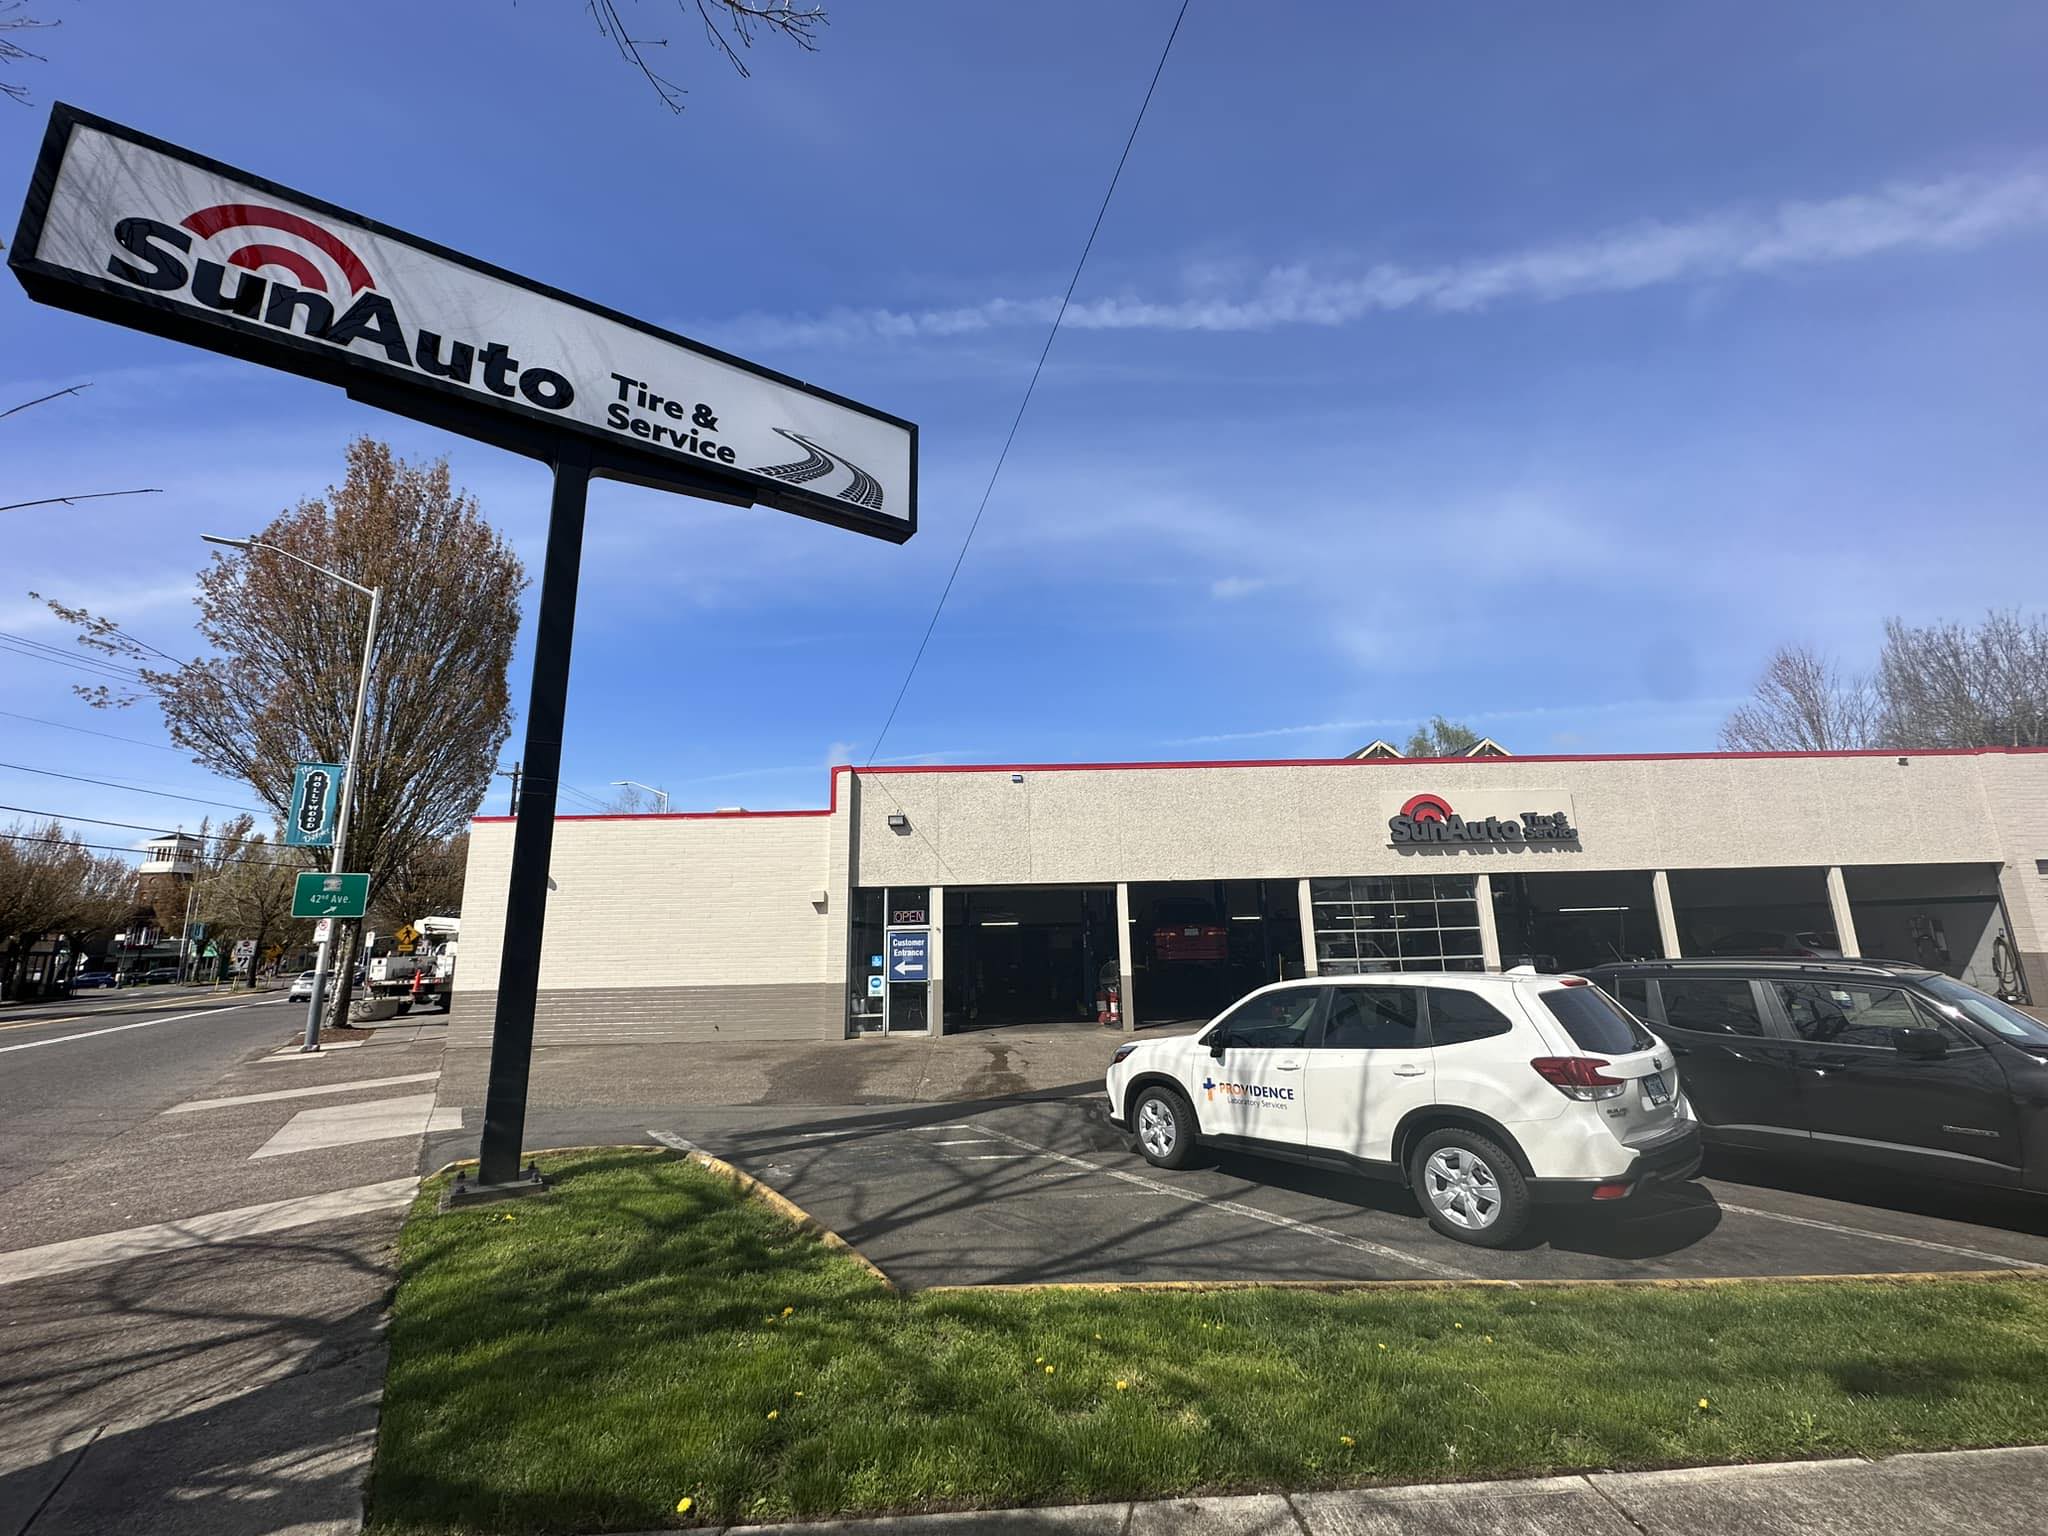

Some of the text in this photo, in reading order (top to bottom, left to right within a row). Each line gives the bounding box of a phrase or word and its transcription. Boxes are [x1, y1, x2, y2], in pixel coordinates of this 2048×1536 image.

[108, 217, 719, 432] SunAuto Tire &
[607, 403, 736, 464] Service
[306, 775, 322, 829] HOLLYWOOD
[1389, 811, 1568, 842] SunAuto Tire &
[1523, 826, 1578, 840] Service
[310, 894, 351, 904] 42nd Ave.
[895, 911, 925, 922] OPEN
[893, 938, 925, 948] Customer
[893, 948, 924, 957] Entrance
[1219, 1082, 1295, 1101] PROVIDENCE
[1228, 1097, 1288, 1110] Laboratory Services
